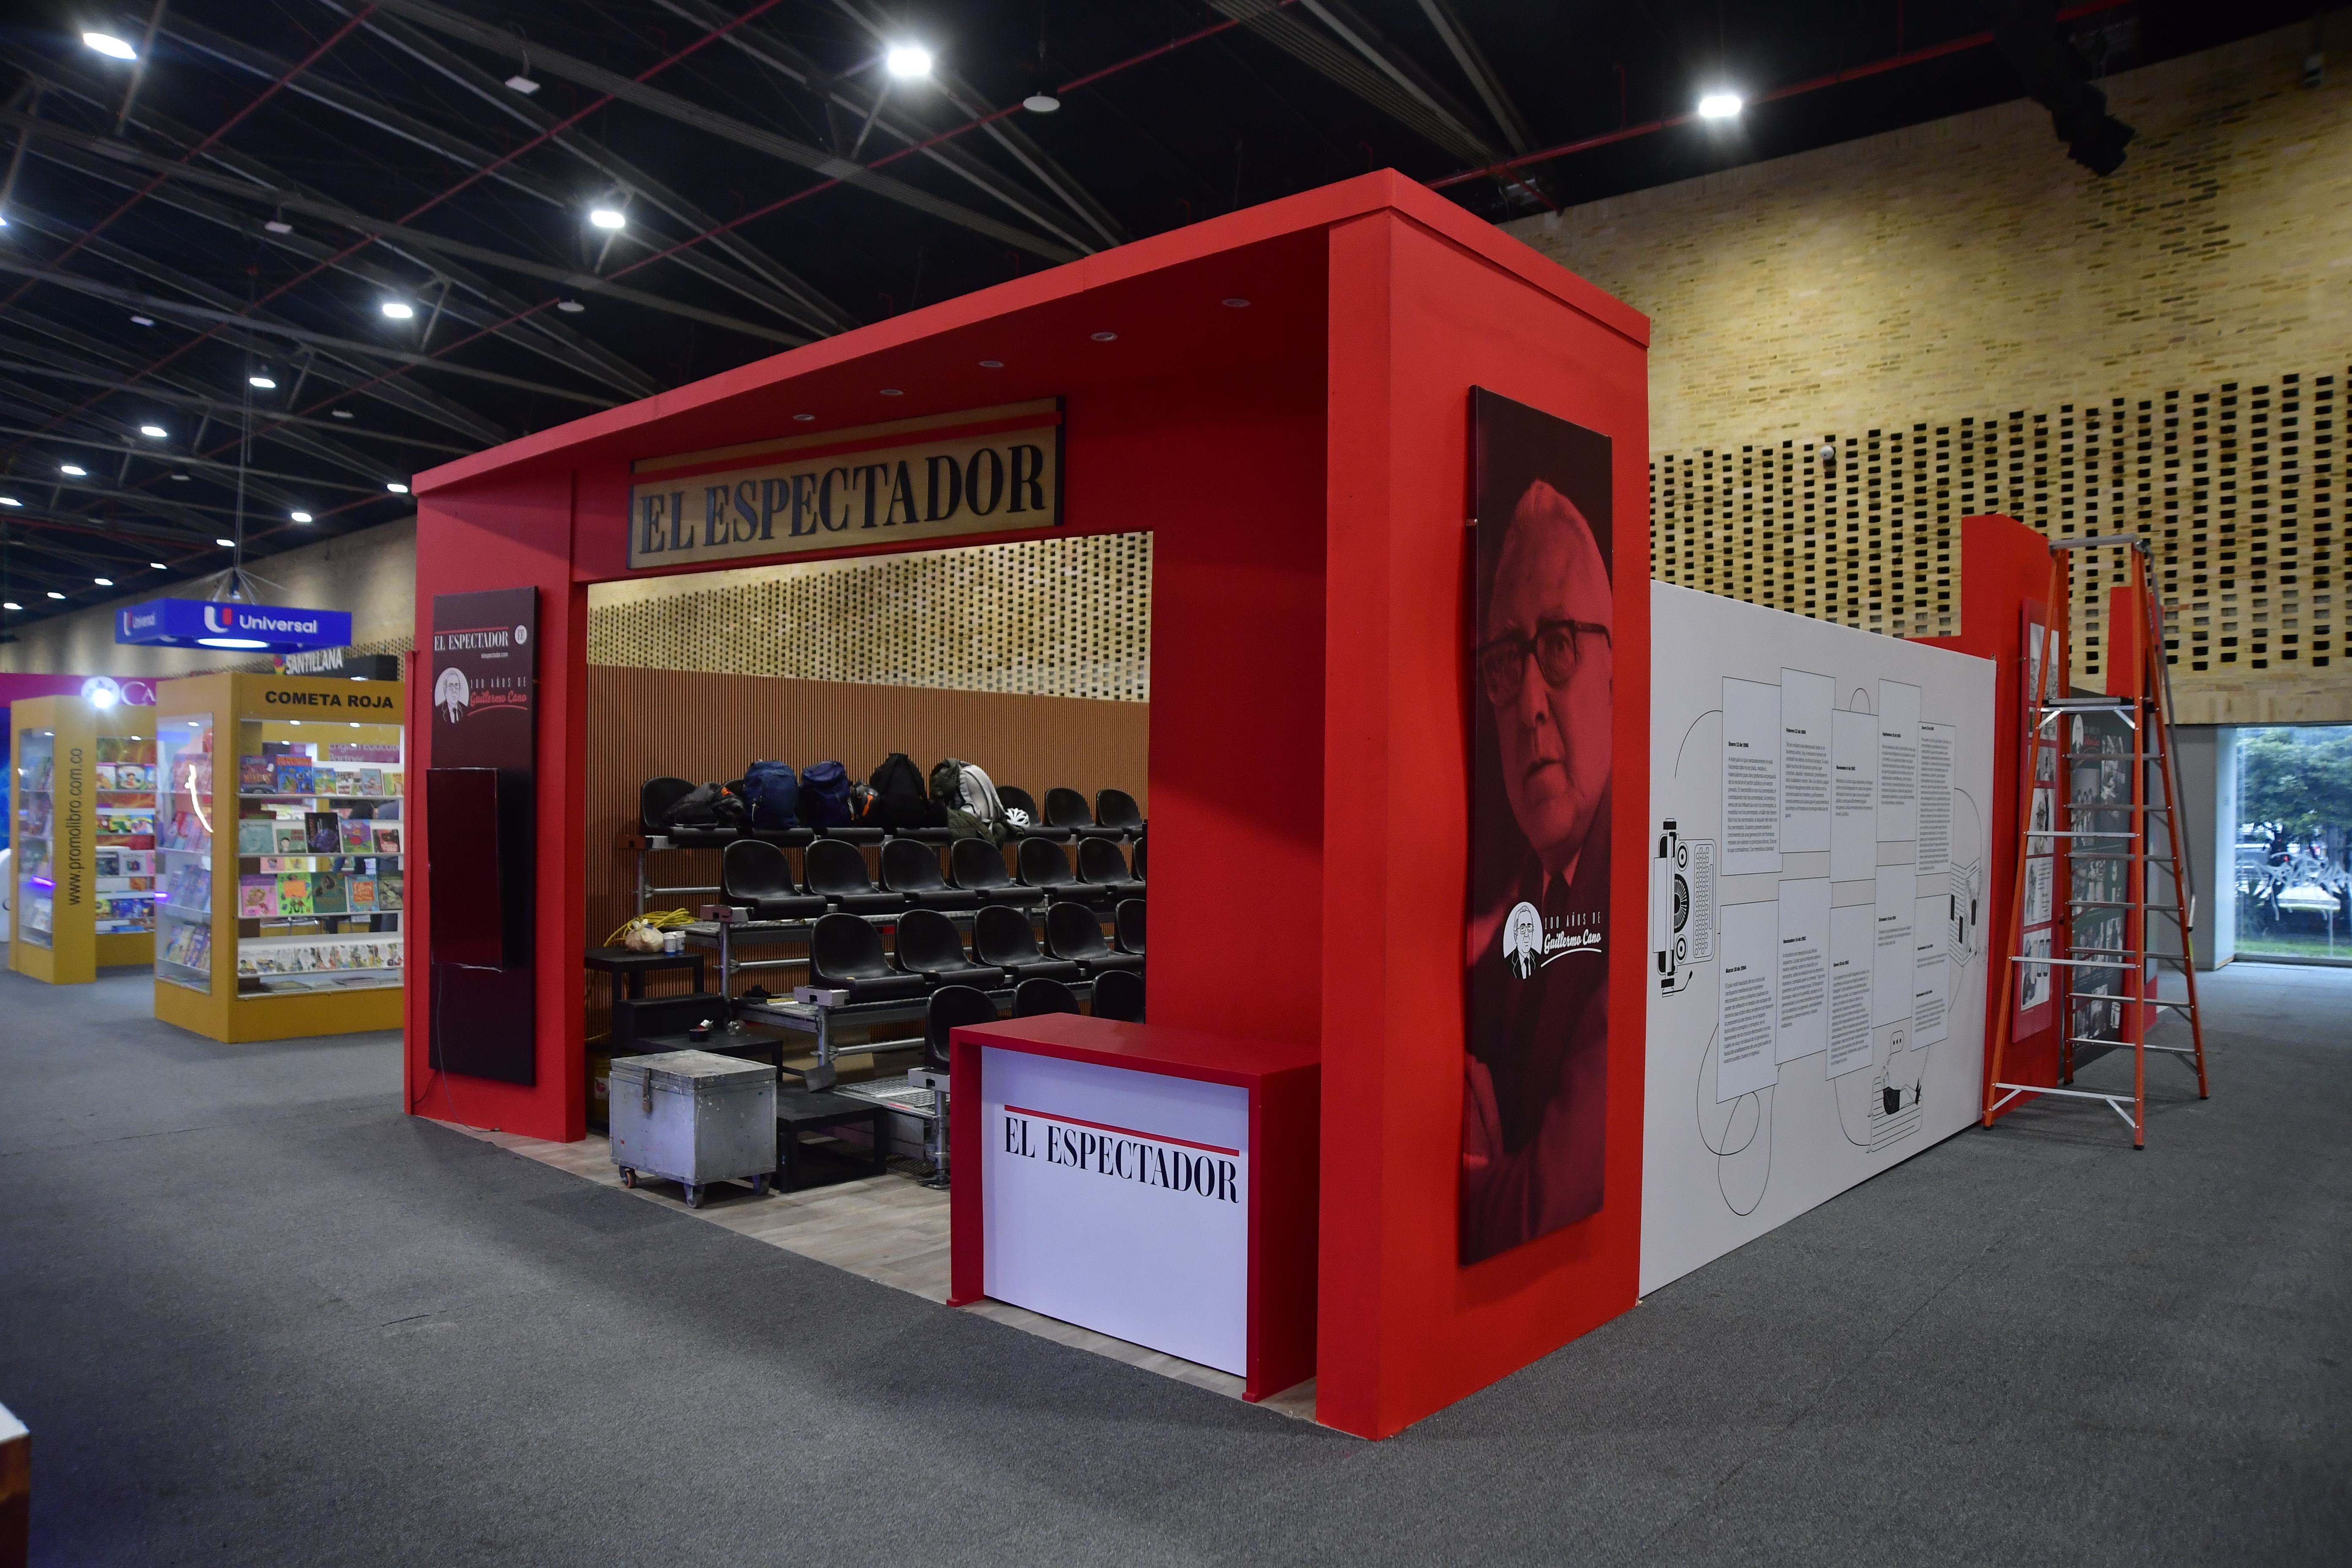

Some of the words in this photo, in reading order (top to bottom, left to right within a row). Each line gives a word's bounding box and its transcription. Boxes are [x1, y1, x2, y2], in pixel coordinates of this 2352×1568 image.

[640, 491, 694, 554] EL
[703, 444, 1046, 546] ESPECTADOR
[239, 614, 318, 634] Universal
[434, 635, 446, 651] EL
[449, 631, 508, 650] ESPECTADOR
[285, 648, 343, 675] SANTILLANA
[471, 678, 484, 689] 100
[491, 676, 510, 687] AÑOS
[518, 677, 526, 687] DE
[265, 691, 341, 706] COMETA
[348, 695, 393, 708] ROJA
[470, 691, 506, 707] Guillermo
[508, 690, 527, 703] Cano
[65, 748, 85, 906] www.promolibro.com.co
[1544, 916, 1559, 929] 100
[1566, 912, 1586, 927] AÑOS
[1592, 912, 1601, 924] DE
[1544, 930, 1582, 954] Guillermo
[1583, 928, 1601, 945] Cano
[1004, 1116, 1035, 1158] EL
[1046, 1125, 1239, 1203] ESPECTADOR
